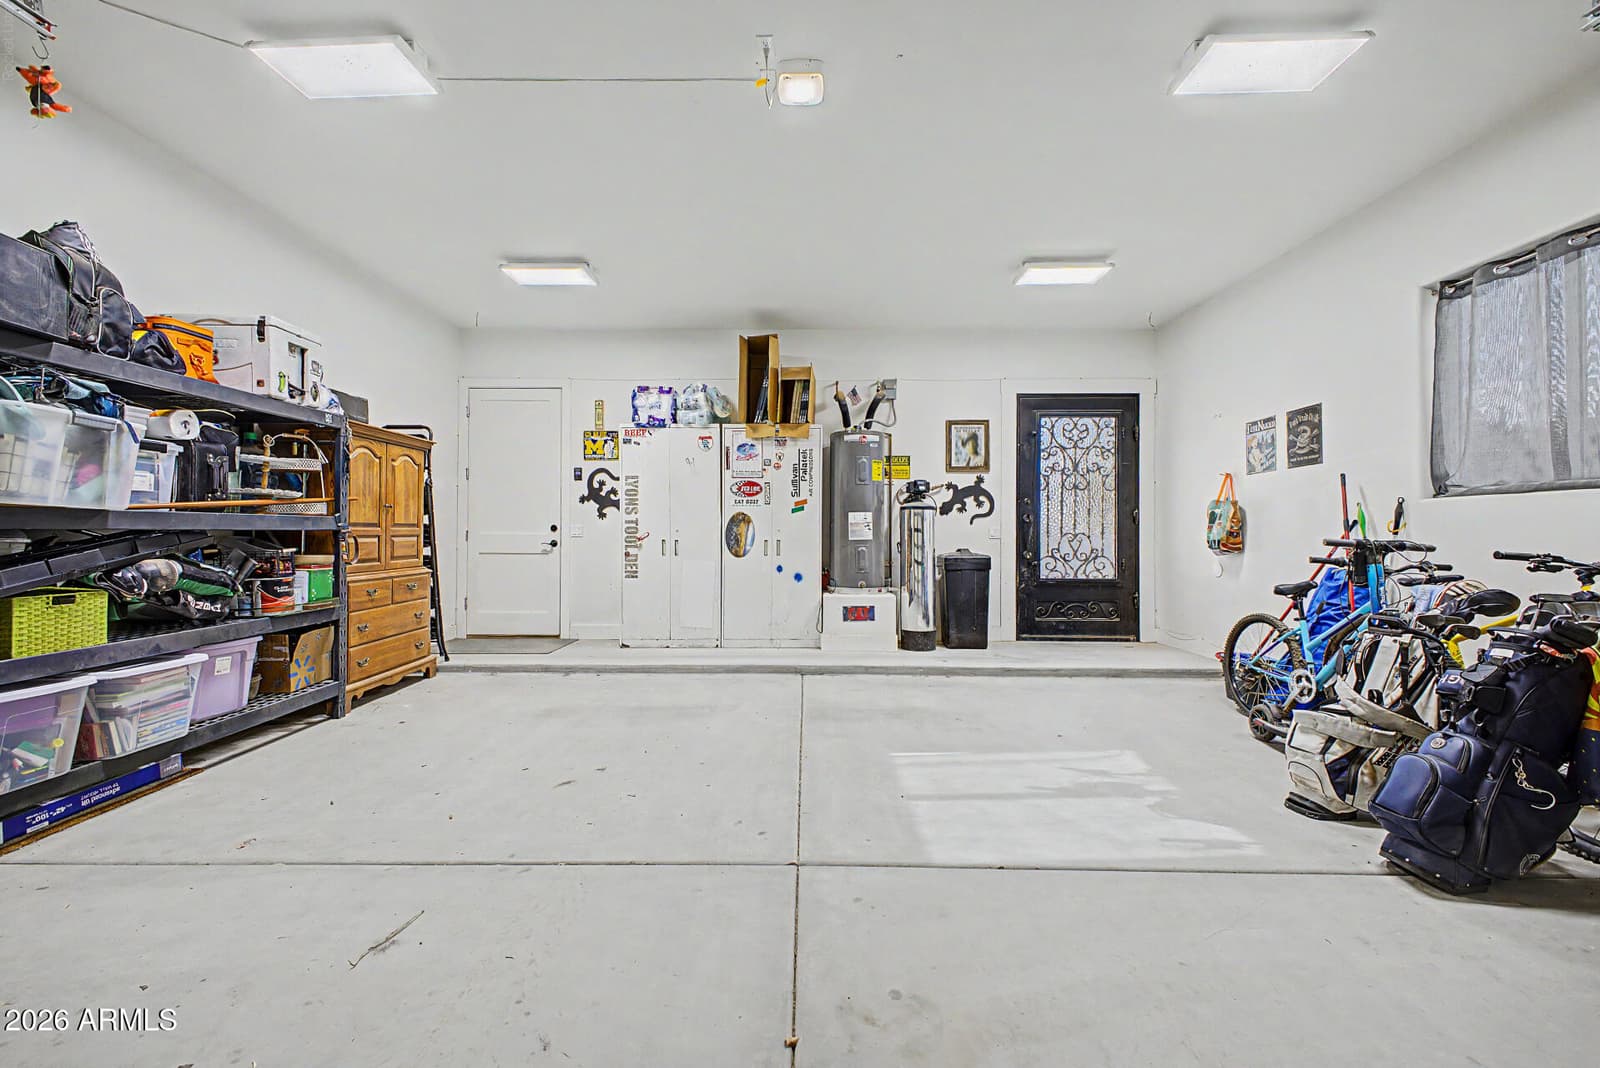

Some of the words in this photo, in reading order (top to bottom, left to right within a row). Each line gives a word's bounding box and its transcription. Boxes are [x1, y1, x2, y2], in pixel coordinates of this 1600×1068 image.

[624, 475, 639, 516] LYONS
[624, 518, 639, 551] TOOL
[624, 553, 639, 579] DEN
[91, 786, 121, 802] advanced
